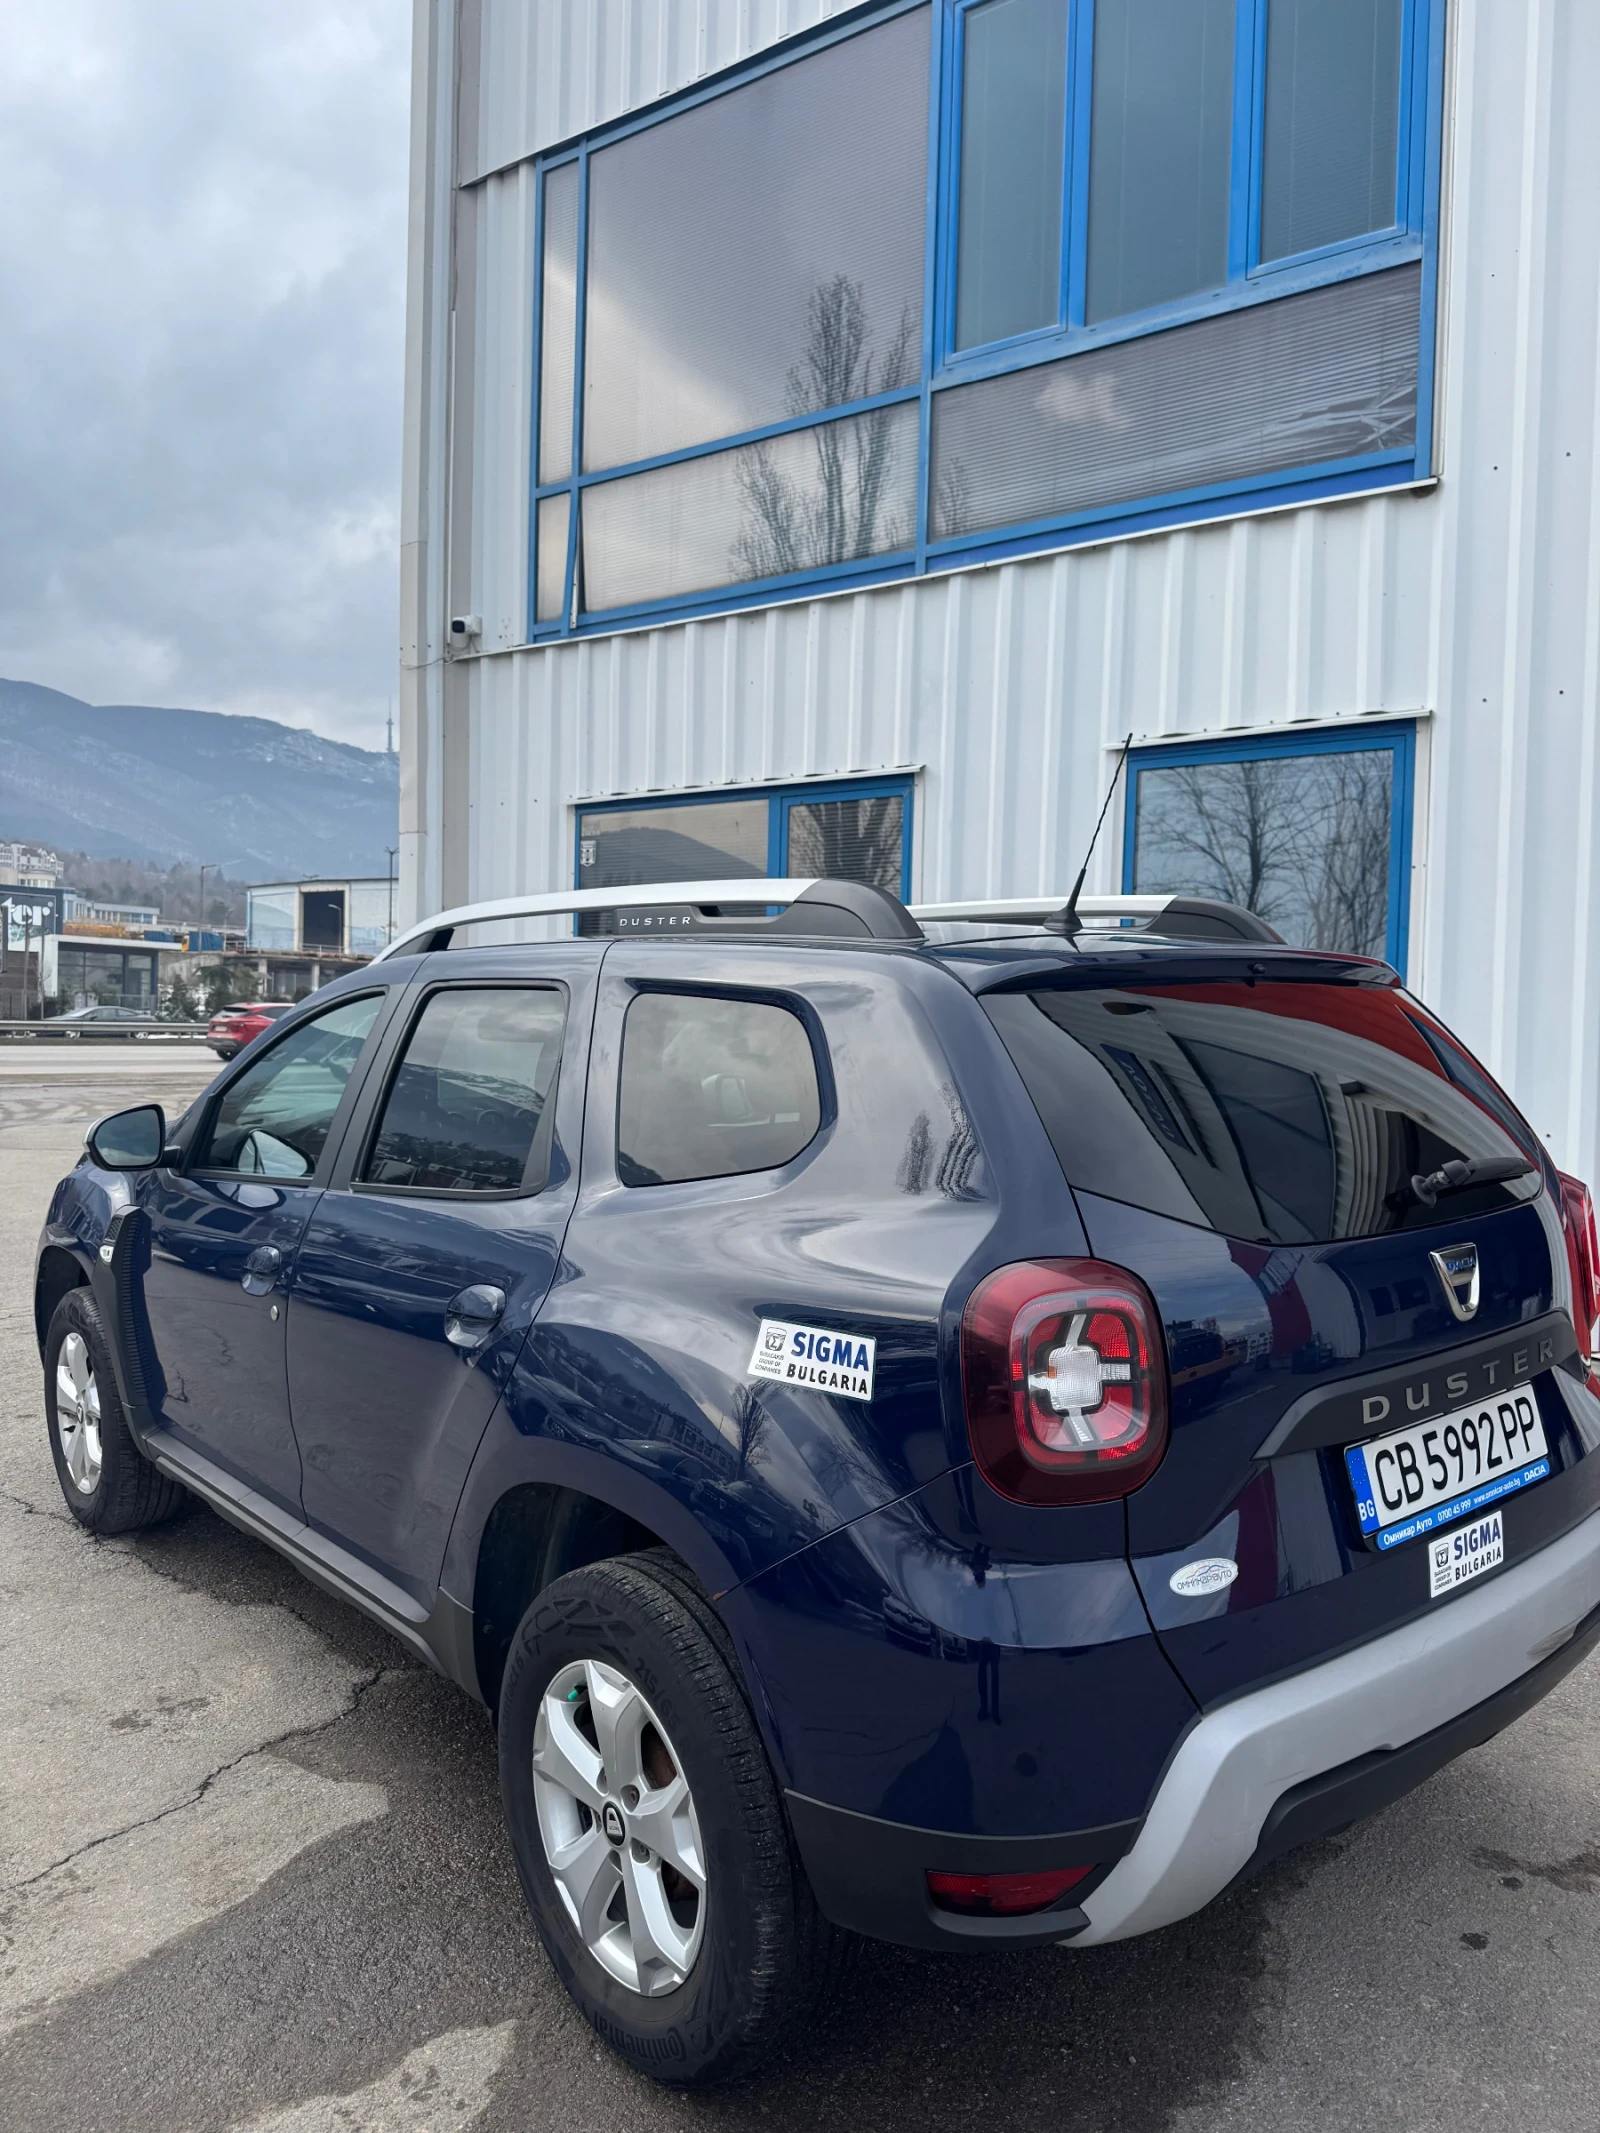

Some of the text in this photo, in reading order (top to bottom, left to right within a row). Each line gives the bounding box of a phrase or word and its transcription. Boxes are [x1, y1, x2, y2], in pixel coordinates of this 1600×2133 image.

[620, 916, 691, 927] DUSTER
[1446, 1256, 1476, 1272] DACIA
[791, 1331, 869, 1372] SIGMA
[786, 1363, 868, 1395] BULGARIA
[1362, 1337, 1553, 1425] DUSTER
[1524, 1464, 1547, 1482] DACIA
[1357, 1499, 1375, 1522] BG
[1437, 1499, 1472, 1522] 0700 45 999
[1383, 1517, 1433, 1546] Омникар Ауто
[1454, 1518, 1501, 1561] SIGMA
[1455, 1546, 1502, 1581] BULGARIA
[593, 2010, 688, 2067] Continental
